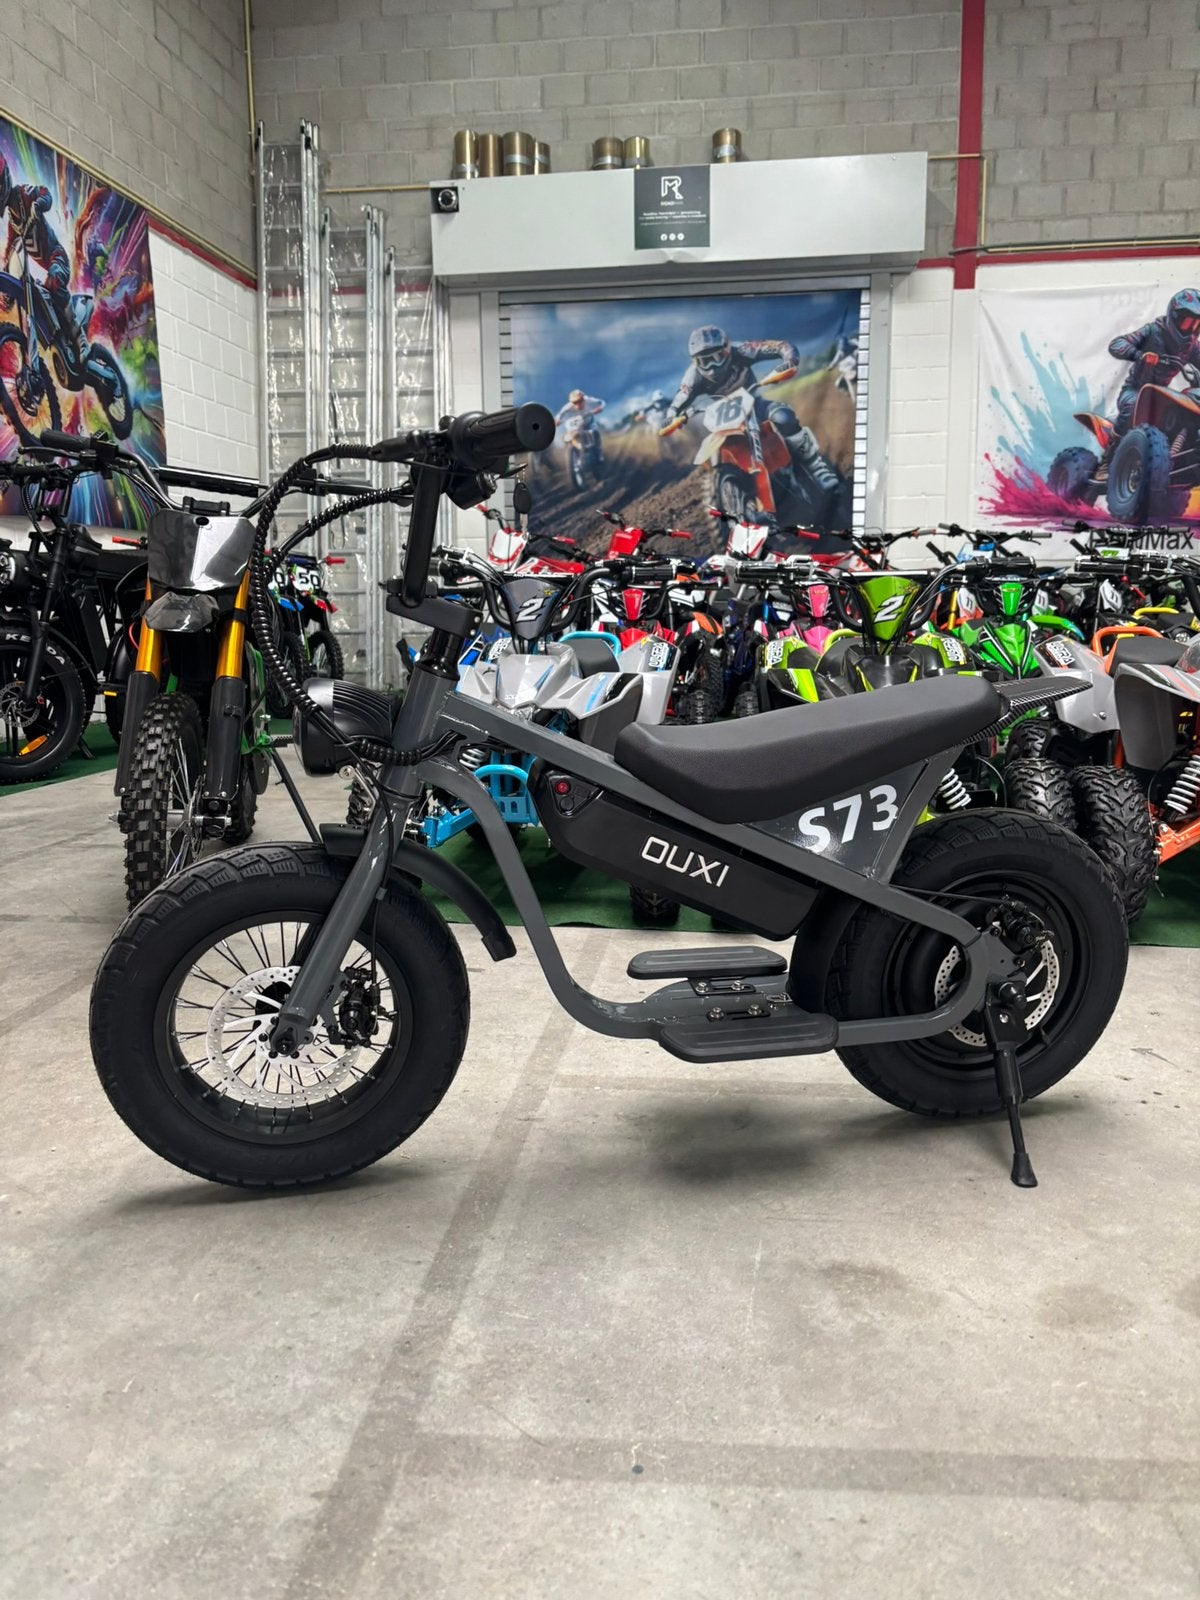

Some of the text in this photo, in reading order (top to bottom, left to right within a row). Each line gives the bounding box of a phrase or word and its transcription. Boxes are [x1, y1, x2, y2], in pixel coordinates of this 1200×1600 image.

[299, 572, 320, 586] 50
[516, 597, 546, 622] 2
[874, 594, 907, 623] 2
[5, 633, 66, 665] KEDA
[798, 784, 899, 855] S73
[641, 836, 730, 887] OUXI
